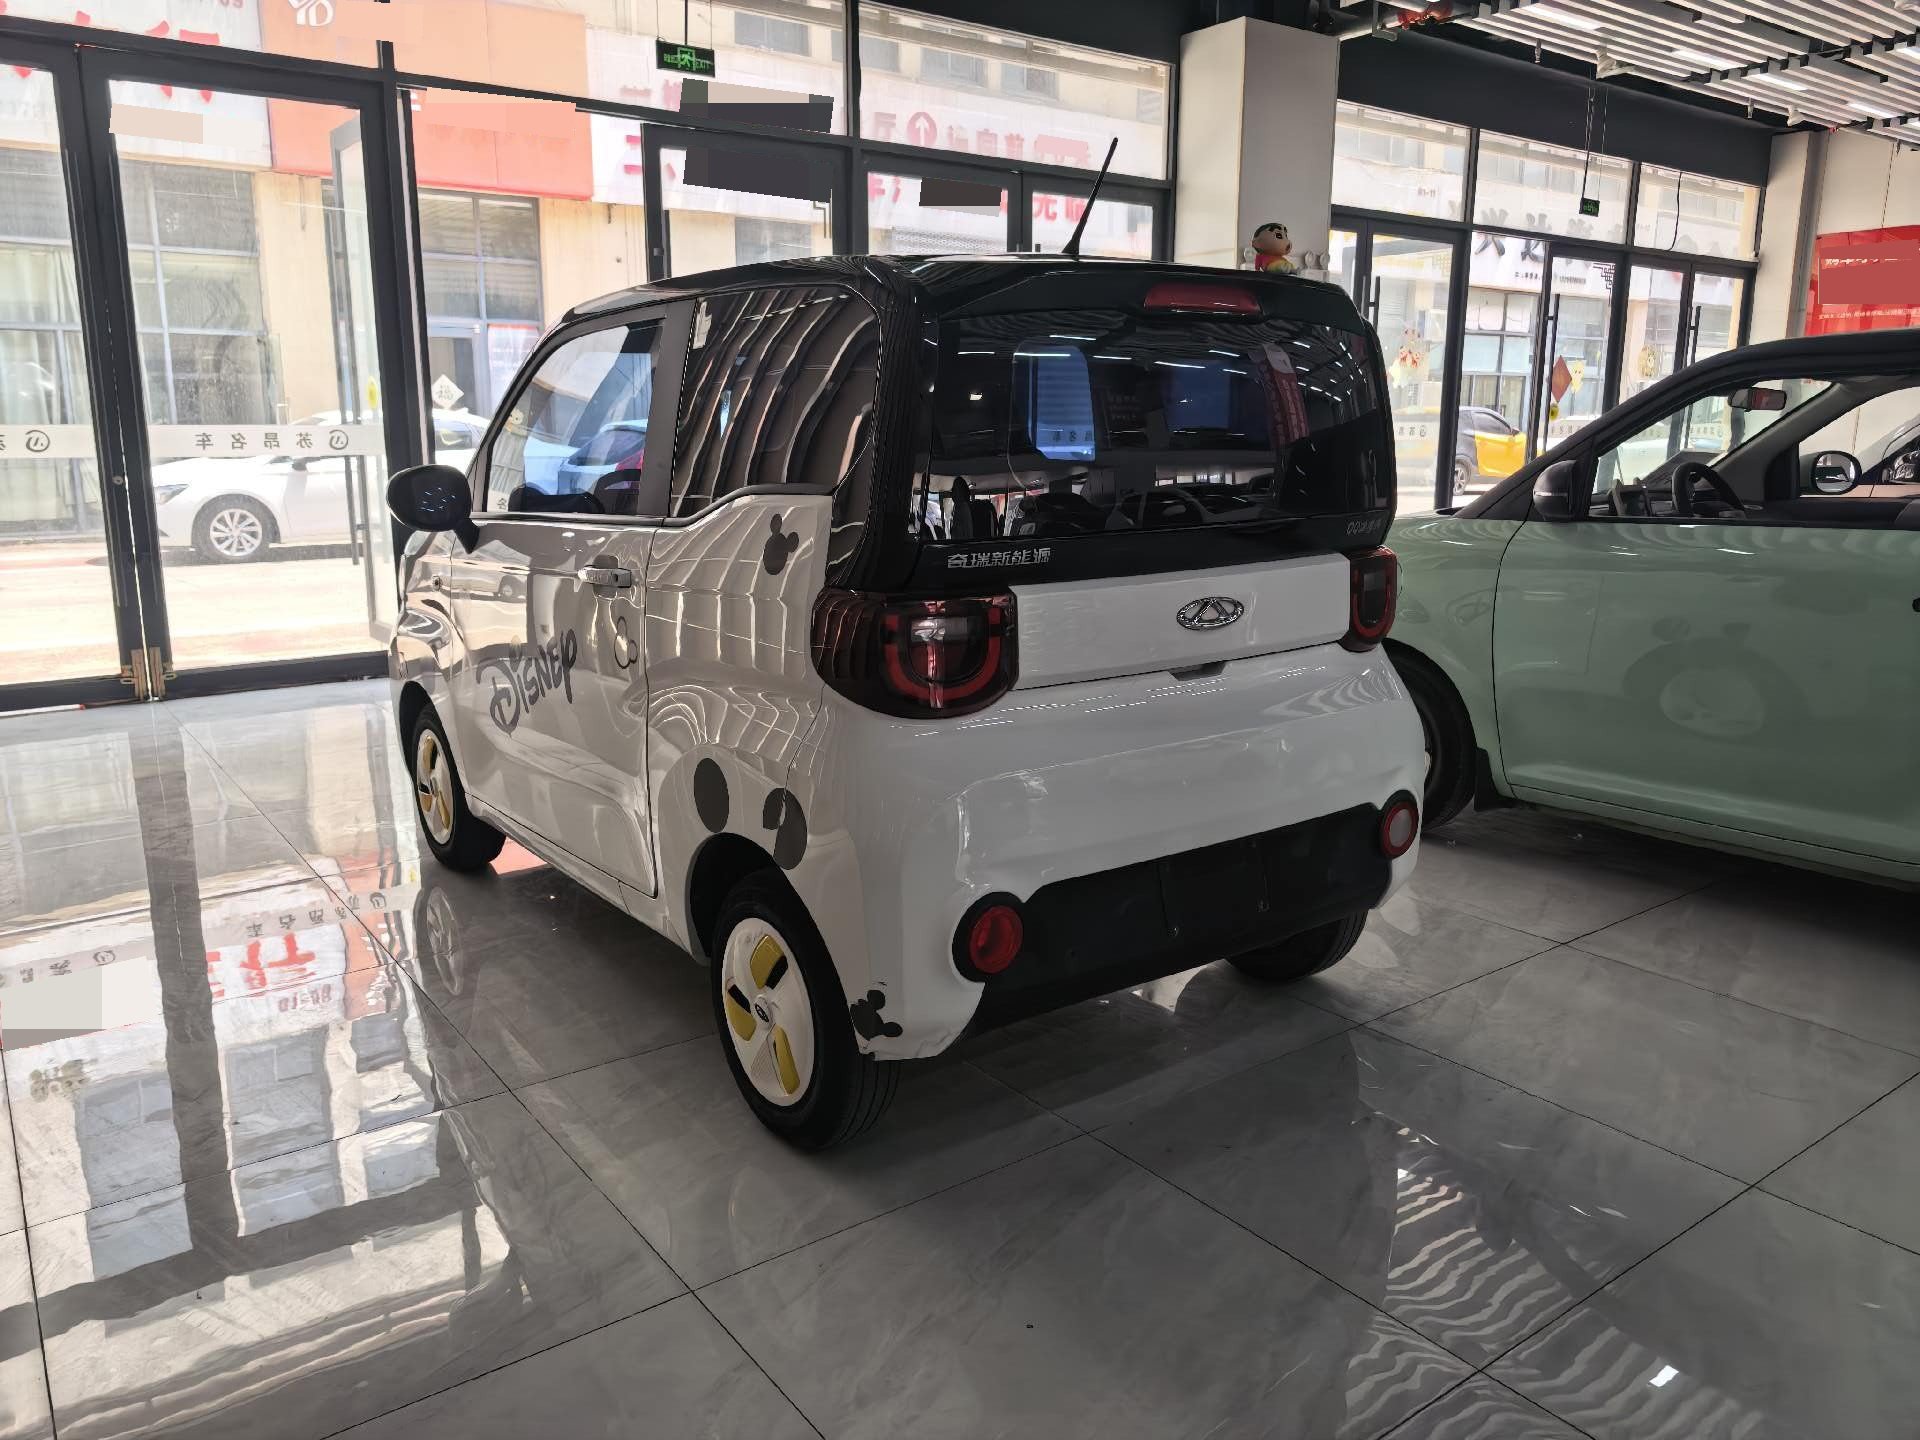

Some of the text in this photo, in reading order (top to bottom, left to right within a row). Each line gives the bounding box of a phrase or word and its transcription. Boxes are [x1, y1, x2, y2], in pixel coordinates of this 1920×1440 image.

[947, 547, 1051, 569] 奇瑞新能源
